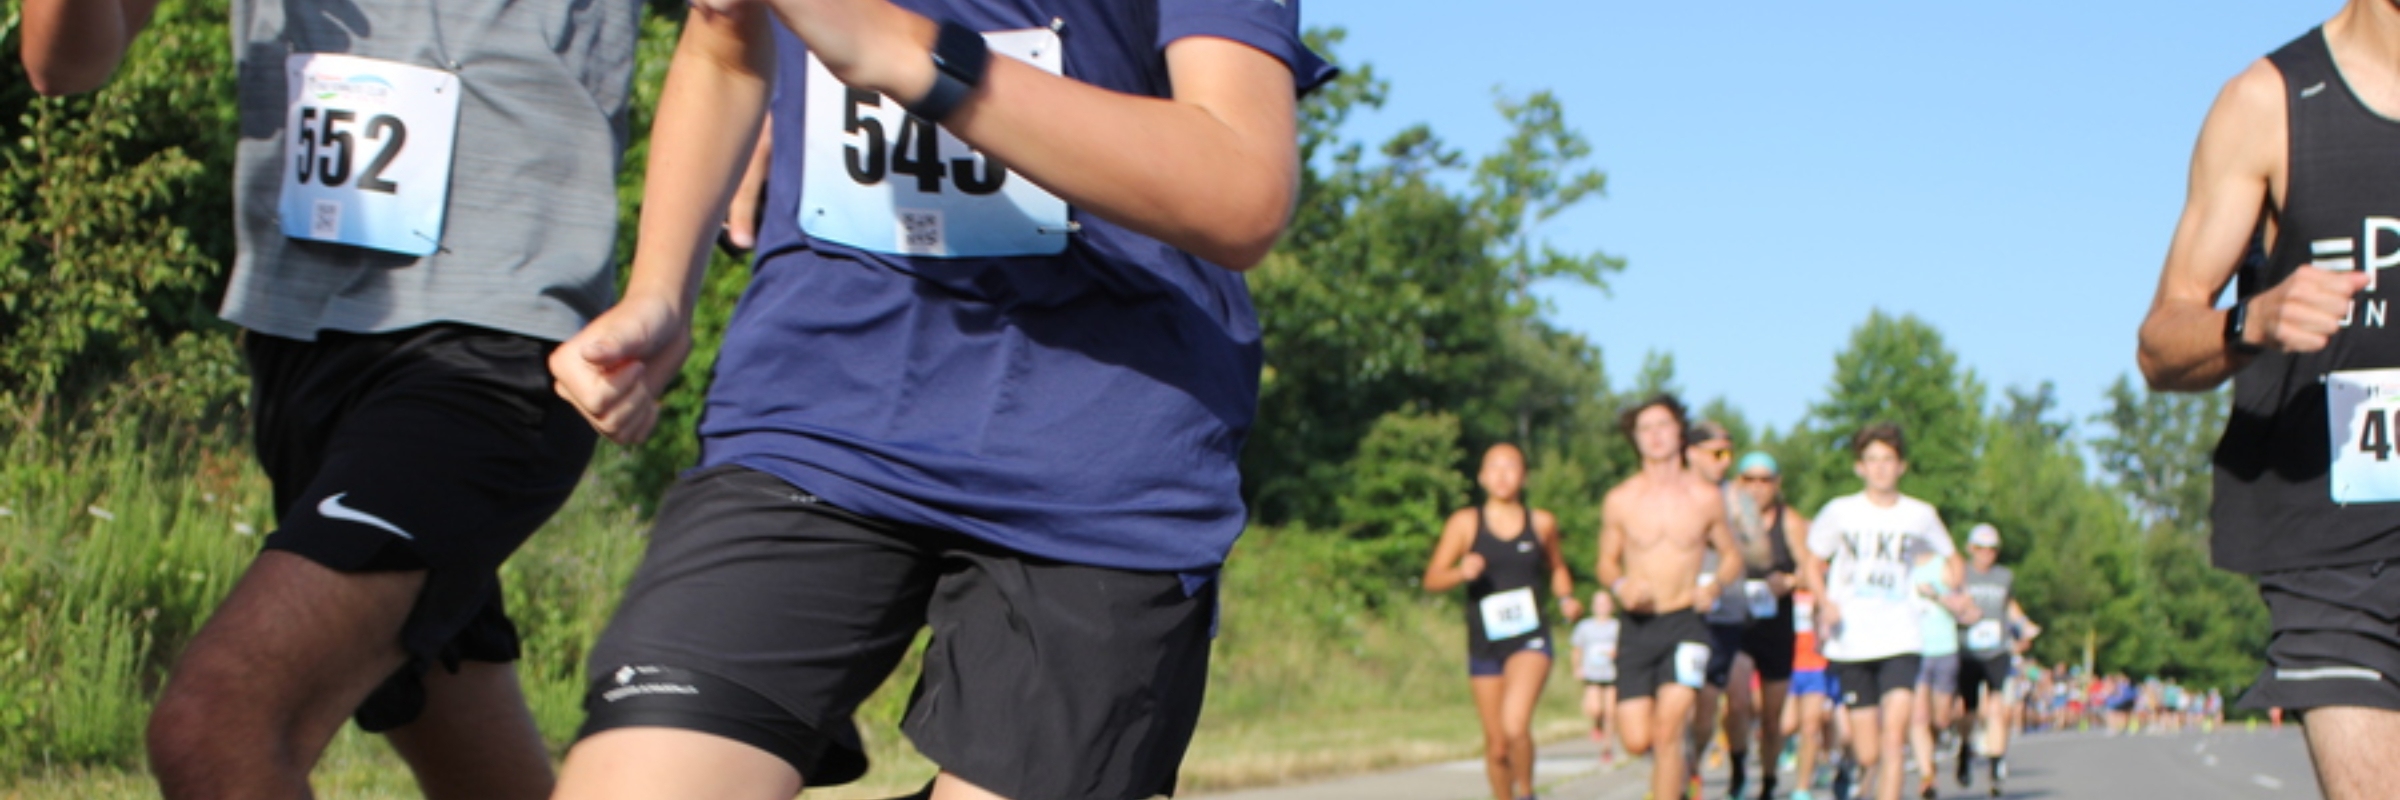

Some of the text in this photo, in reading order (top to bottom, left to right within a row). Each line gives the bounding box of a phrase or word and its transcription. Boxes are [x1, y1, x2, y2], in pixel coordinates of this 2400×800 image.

[296, 106, 407, 195] 552
[2359, 406, 2400, 462] 4
[1840, 530, 1912, 563] NIKE
